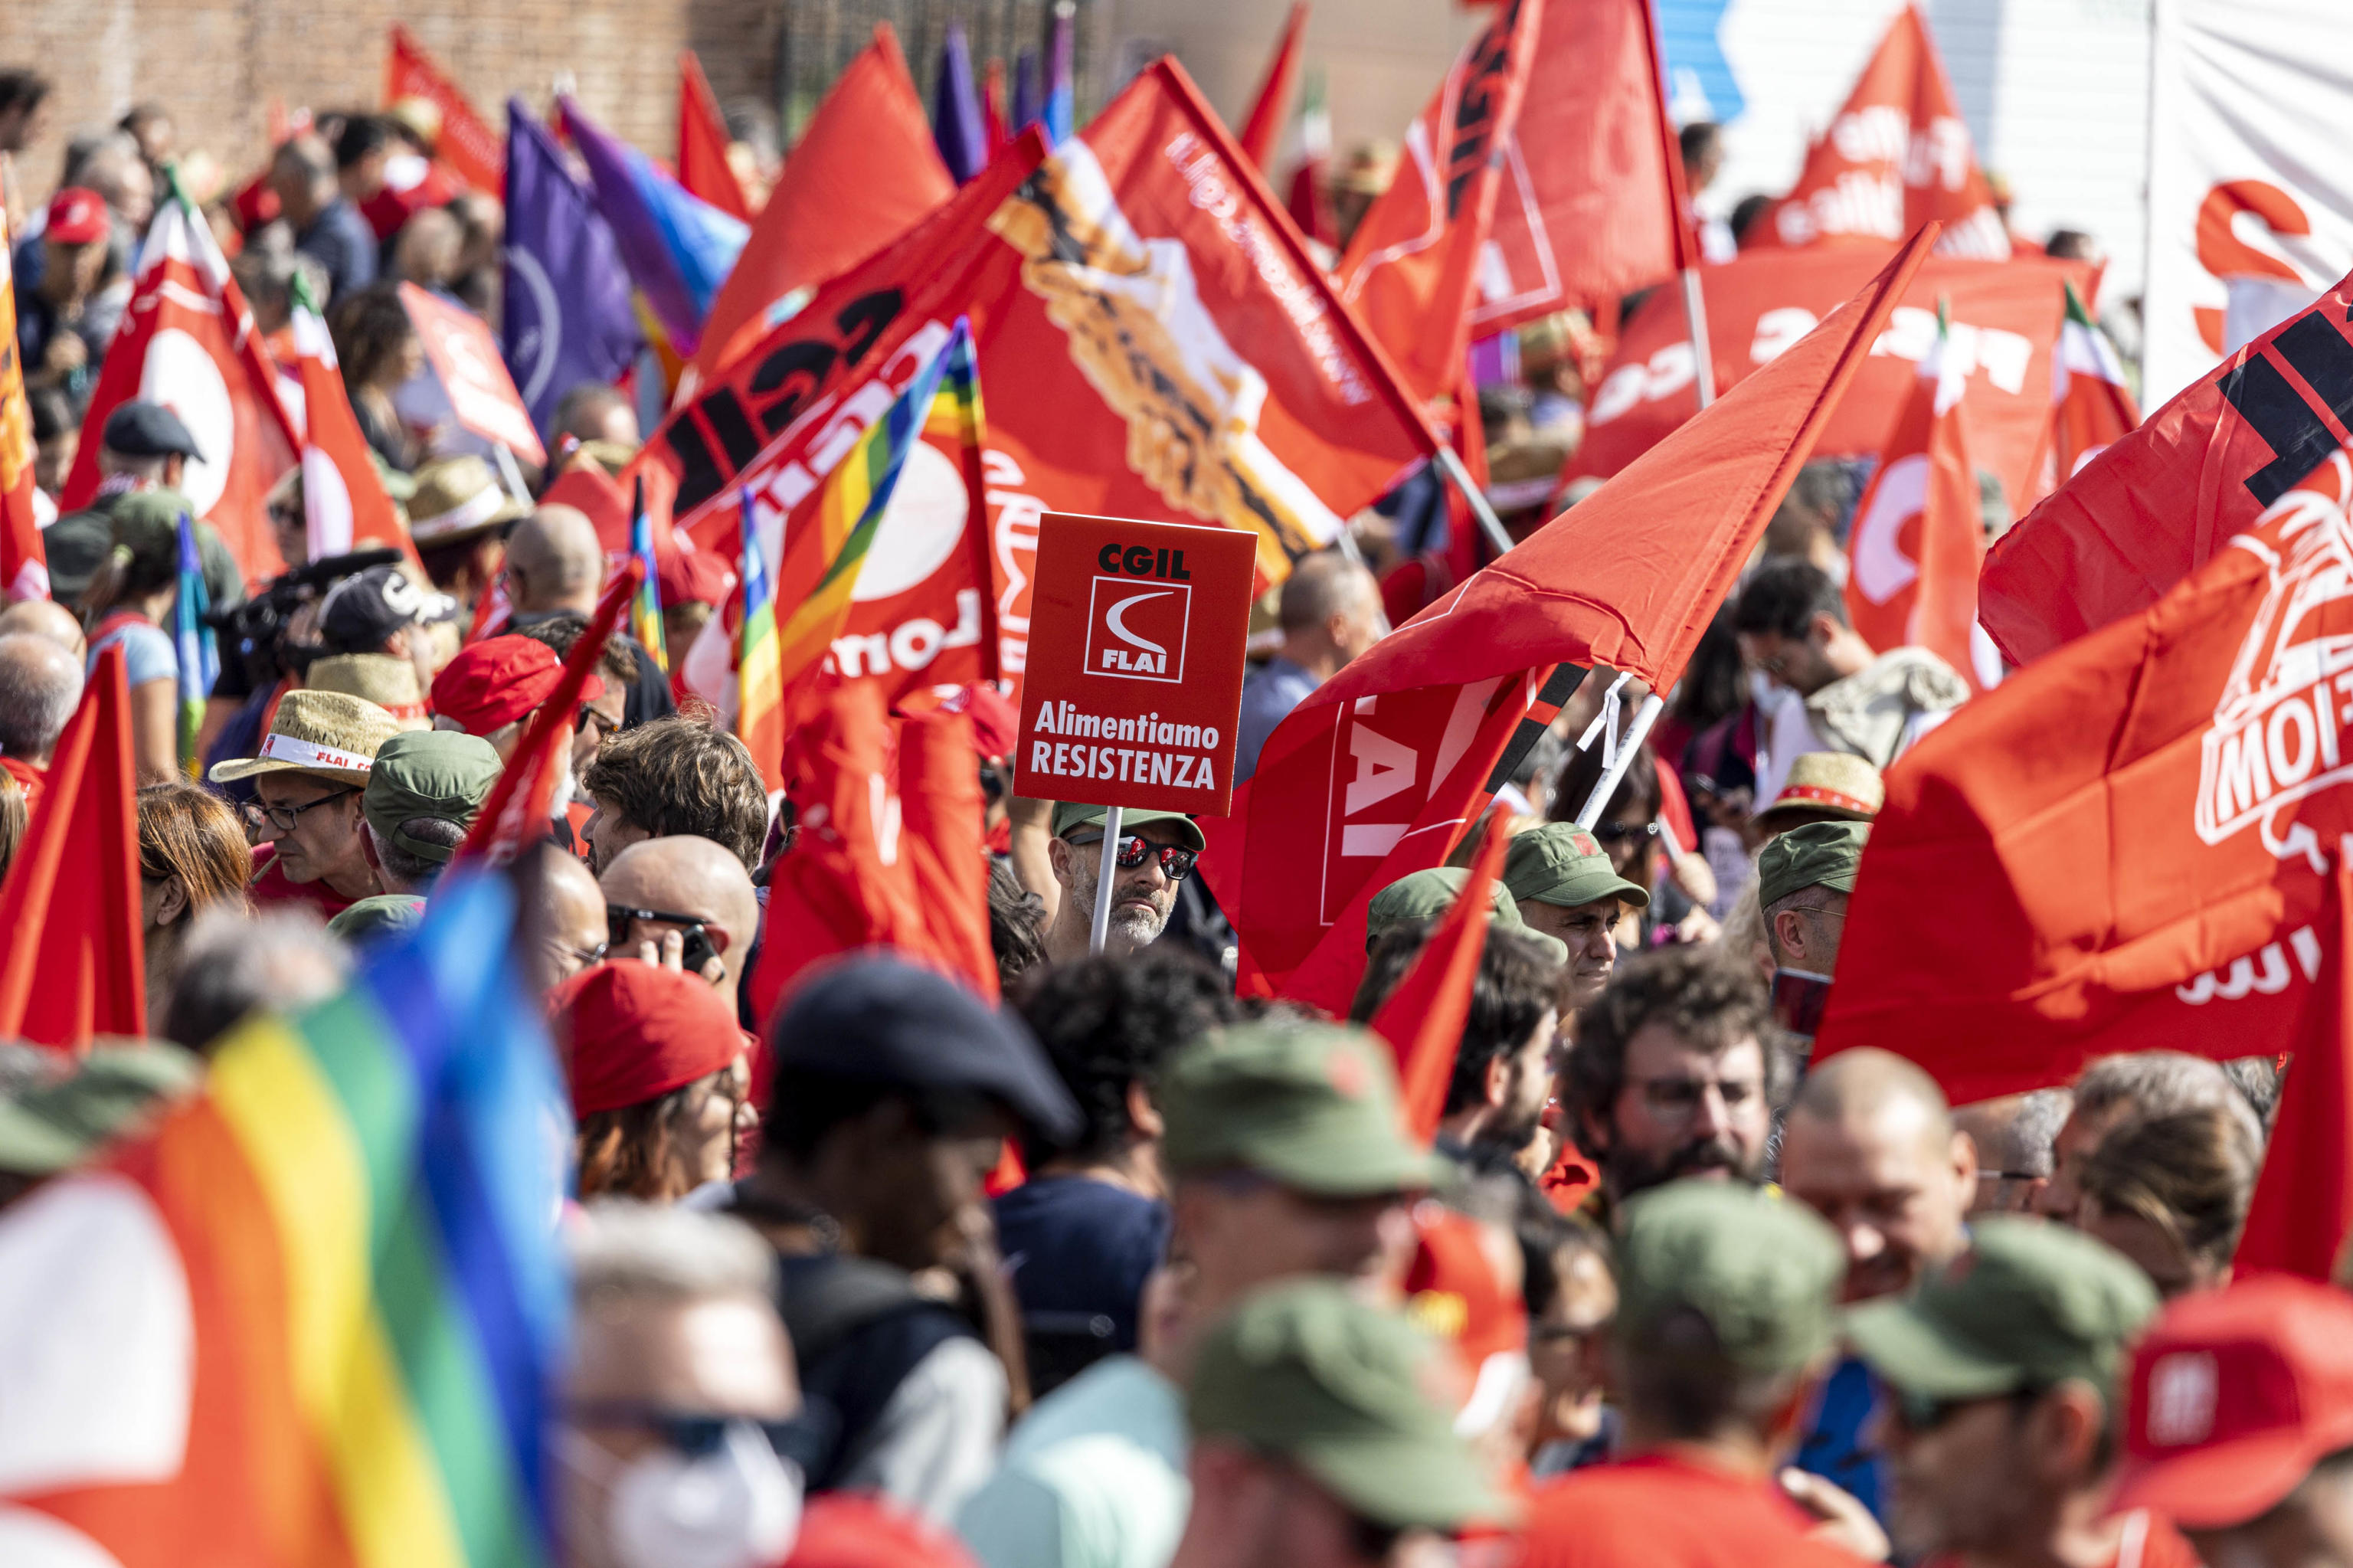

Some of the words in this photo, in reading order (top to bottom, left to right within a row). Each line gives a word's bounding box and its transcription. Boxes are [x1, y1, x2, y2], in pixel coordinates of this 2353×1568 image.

[1098, 543, 1190, 580] CGIL
[1101, 649, 1167, 674] FLAI
[1034, 700, 1219, 750] Alimentiamo
[316, 751, 349, 768] FLAI
[1031, 740, 1216, 790] RESISTENZA
